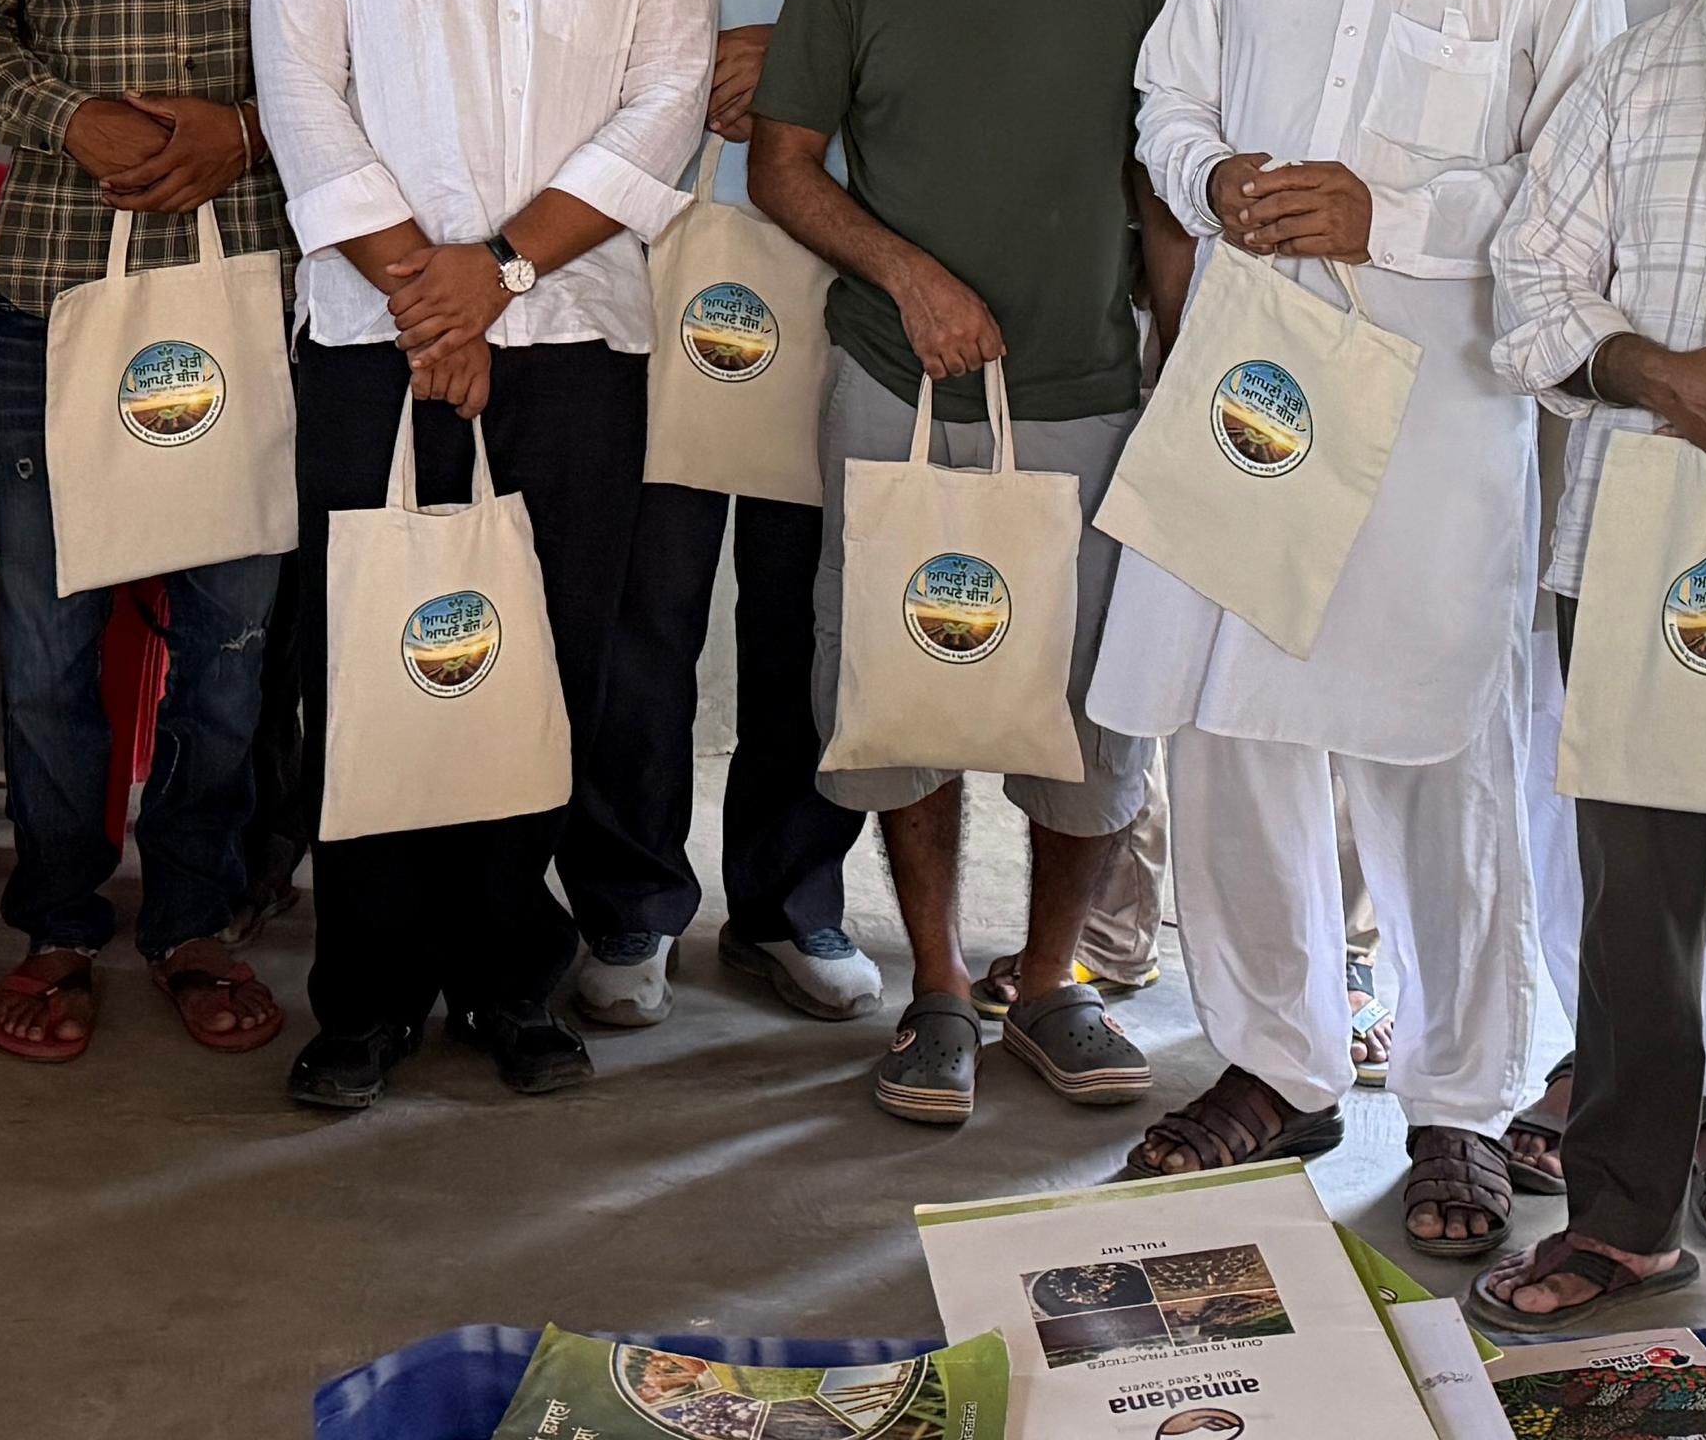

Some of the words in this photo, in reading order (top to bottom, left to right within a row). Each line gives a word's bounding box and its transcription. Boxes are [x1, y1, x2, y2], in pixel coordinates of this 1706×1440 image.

[1169, 1374, 1200, 1386] Seed
[1217, 1369, 1242, 1379] Soil
[1119, 1380, 1164, 1393] Savers
[1109, 1378, 1260, 1413] annadana
